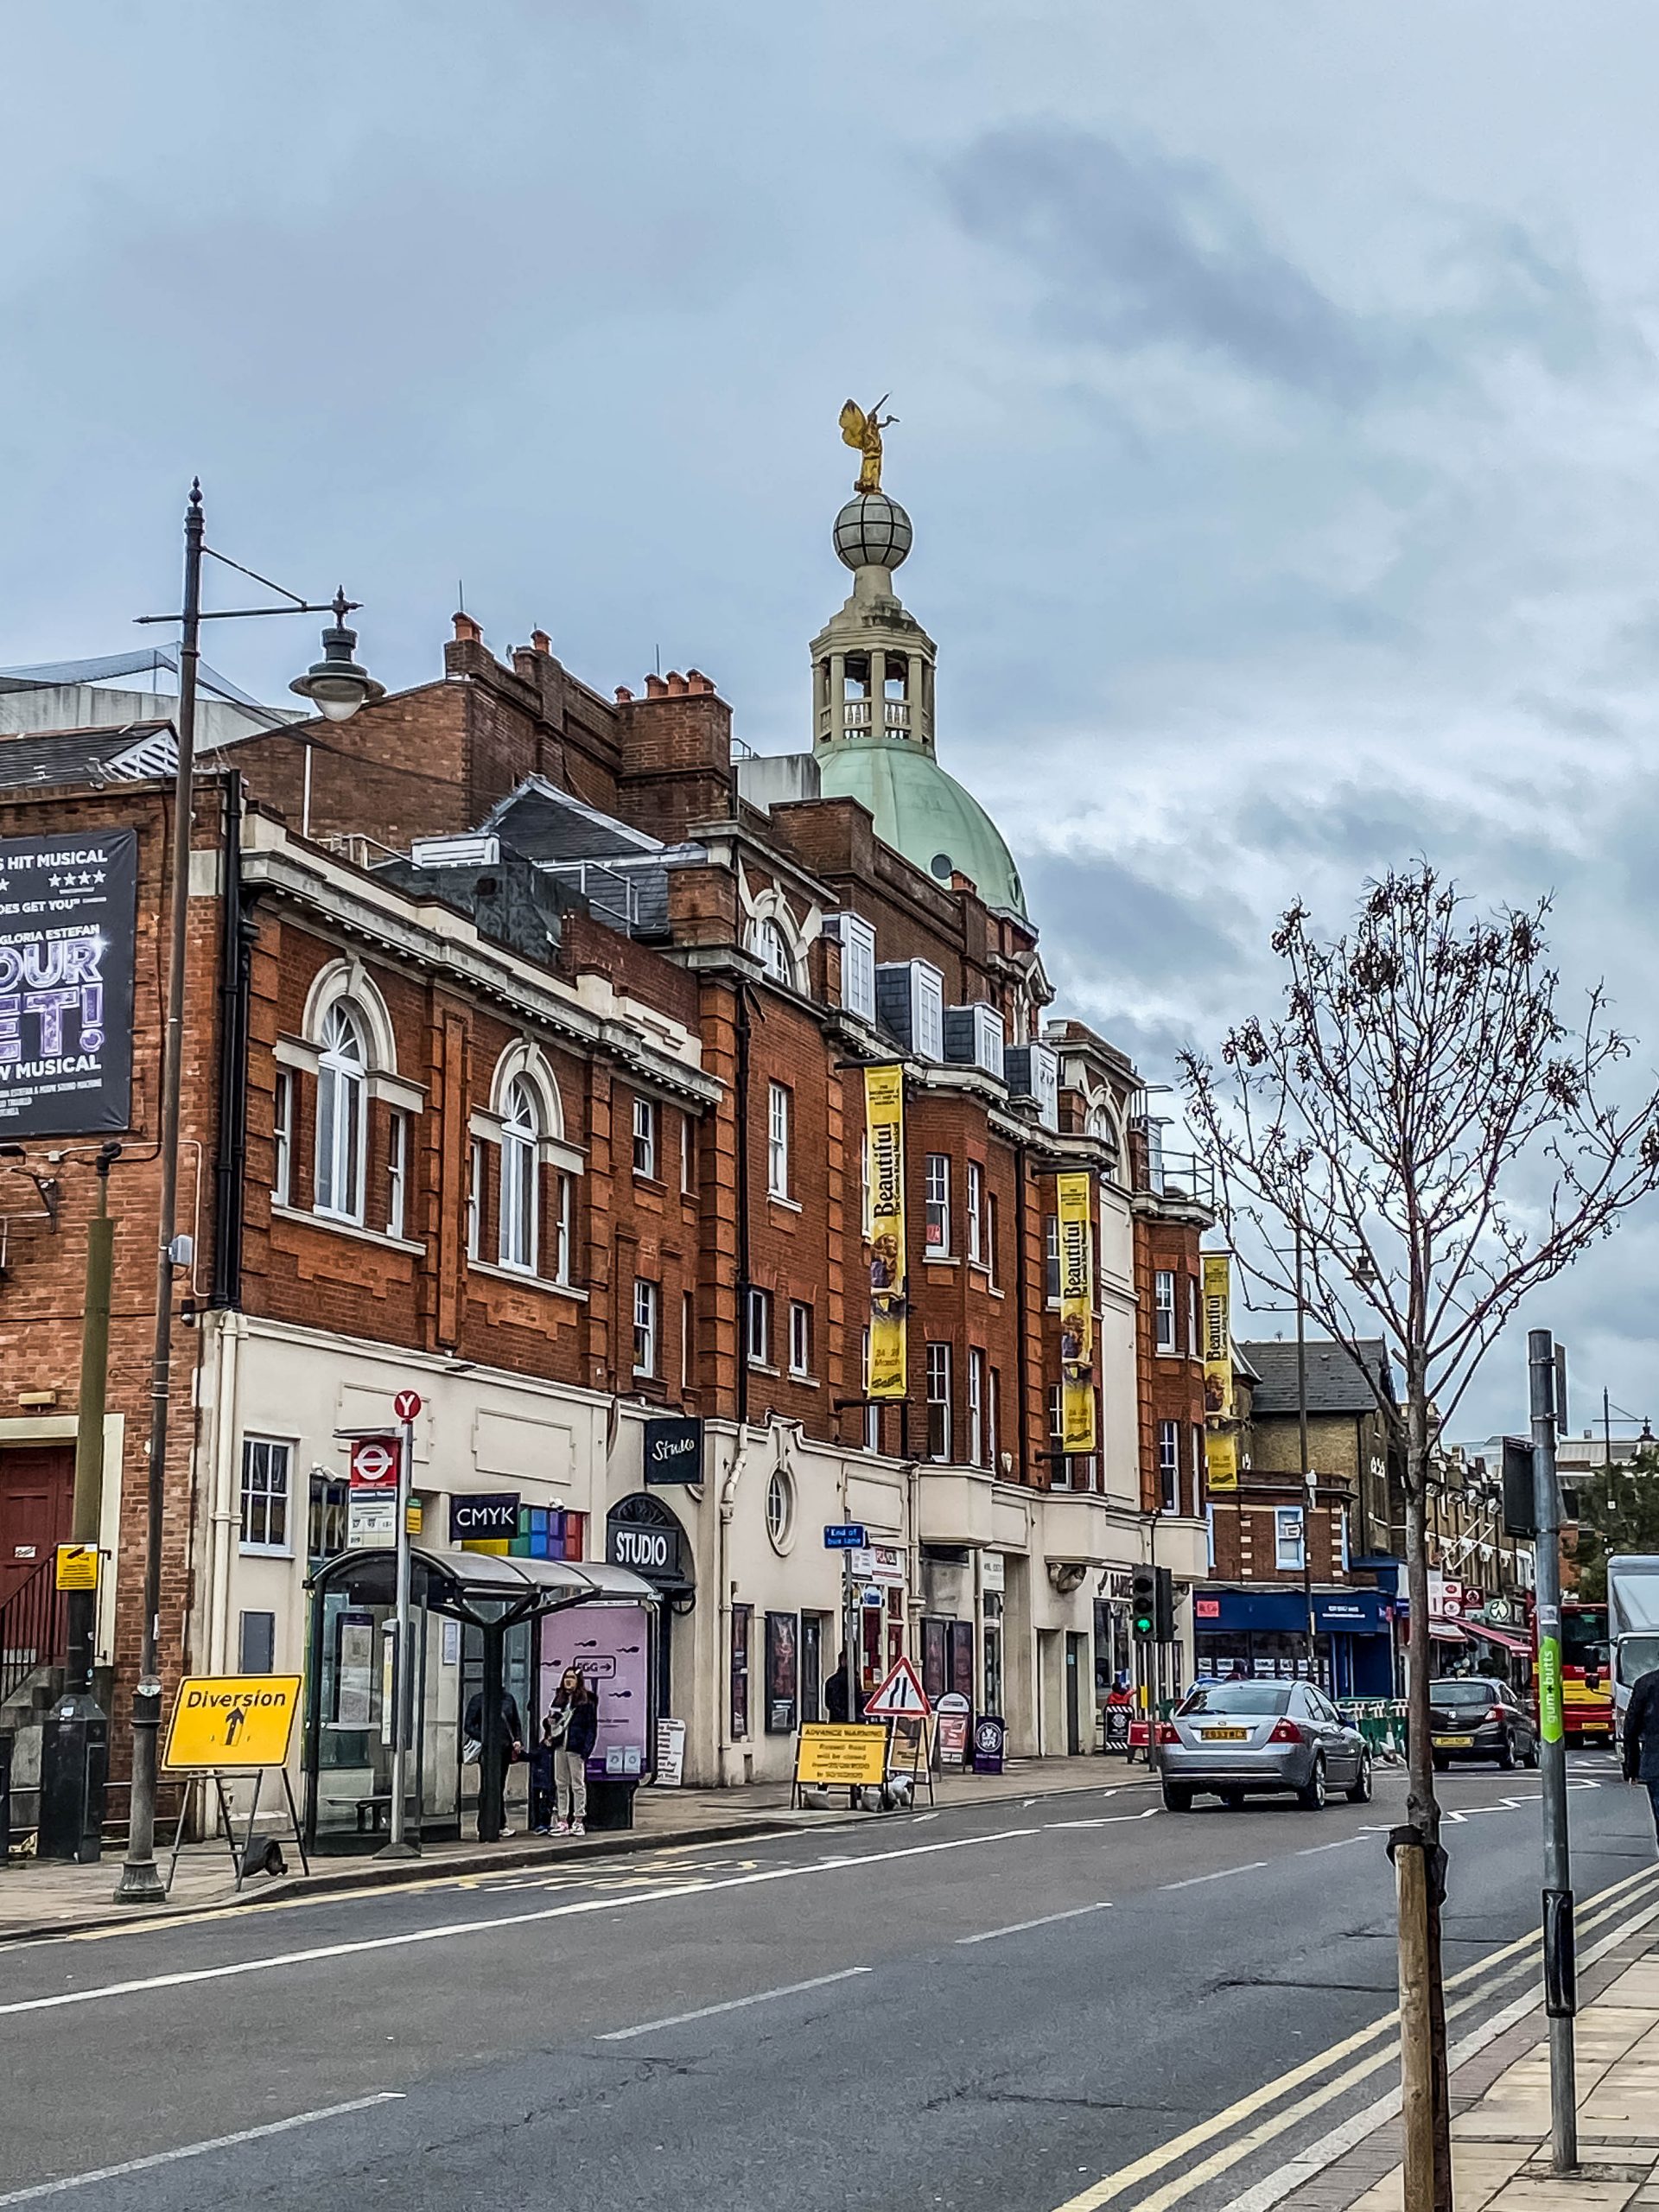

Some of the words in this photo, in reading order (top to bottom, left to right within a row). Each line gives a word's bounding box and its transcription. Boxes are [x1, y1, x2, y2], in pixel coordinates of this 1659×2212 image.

[7, 855, 35, 870] HIT
[36, 849, 108, 868] MUSICAL
[22, 900, 47, 913] GET
[0, 931, 44, 946] GLORIA
[46, 924, 100, 940] ESTEFAN
[16, 1054, 102, 1079] MUSICAL
[873, 1122, 893, 1218] Beautiful
[1063, 1220, 1081, 1300] Beautiful
[1206, 1295, 1220, 1361] Beautiful
[398, 1394, 416, 1416] Y
[456, 1506, 515, 1527] CMYK
[615, 1531, 667, 1567] STUDIO
[187, 1689, 287, 1709] Diversion
